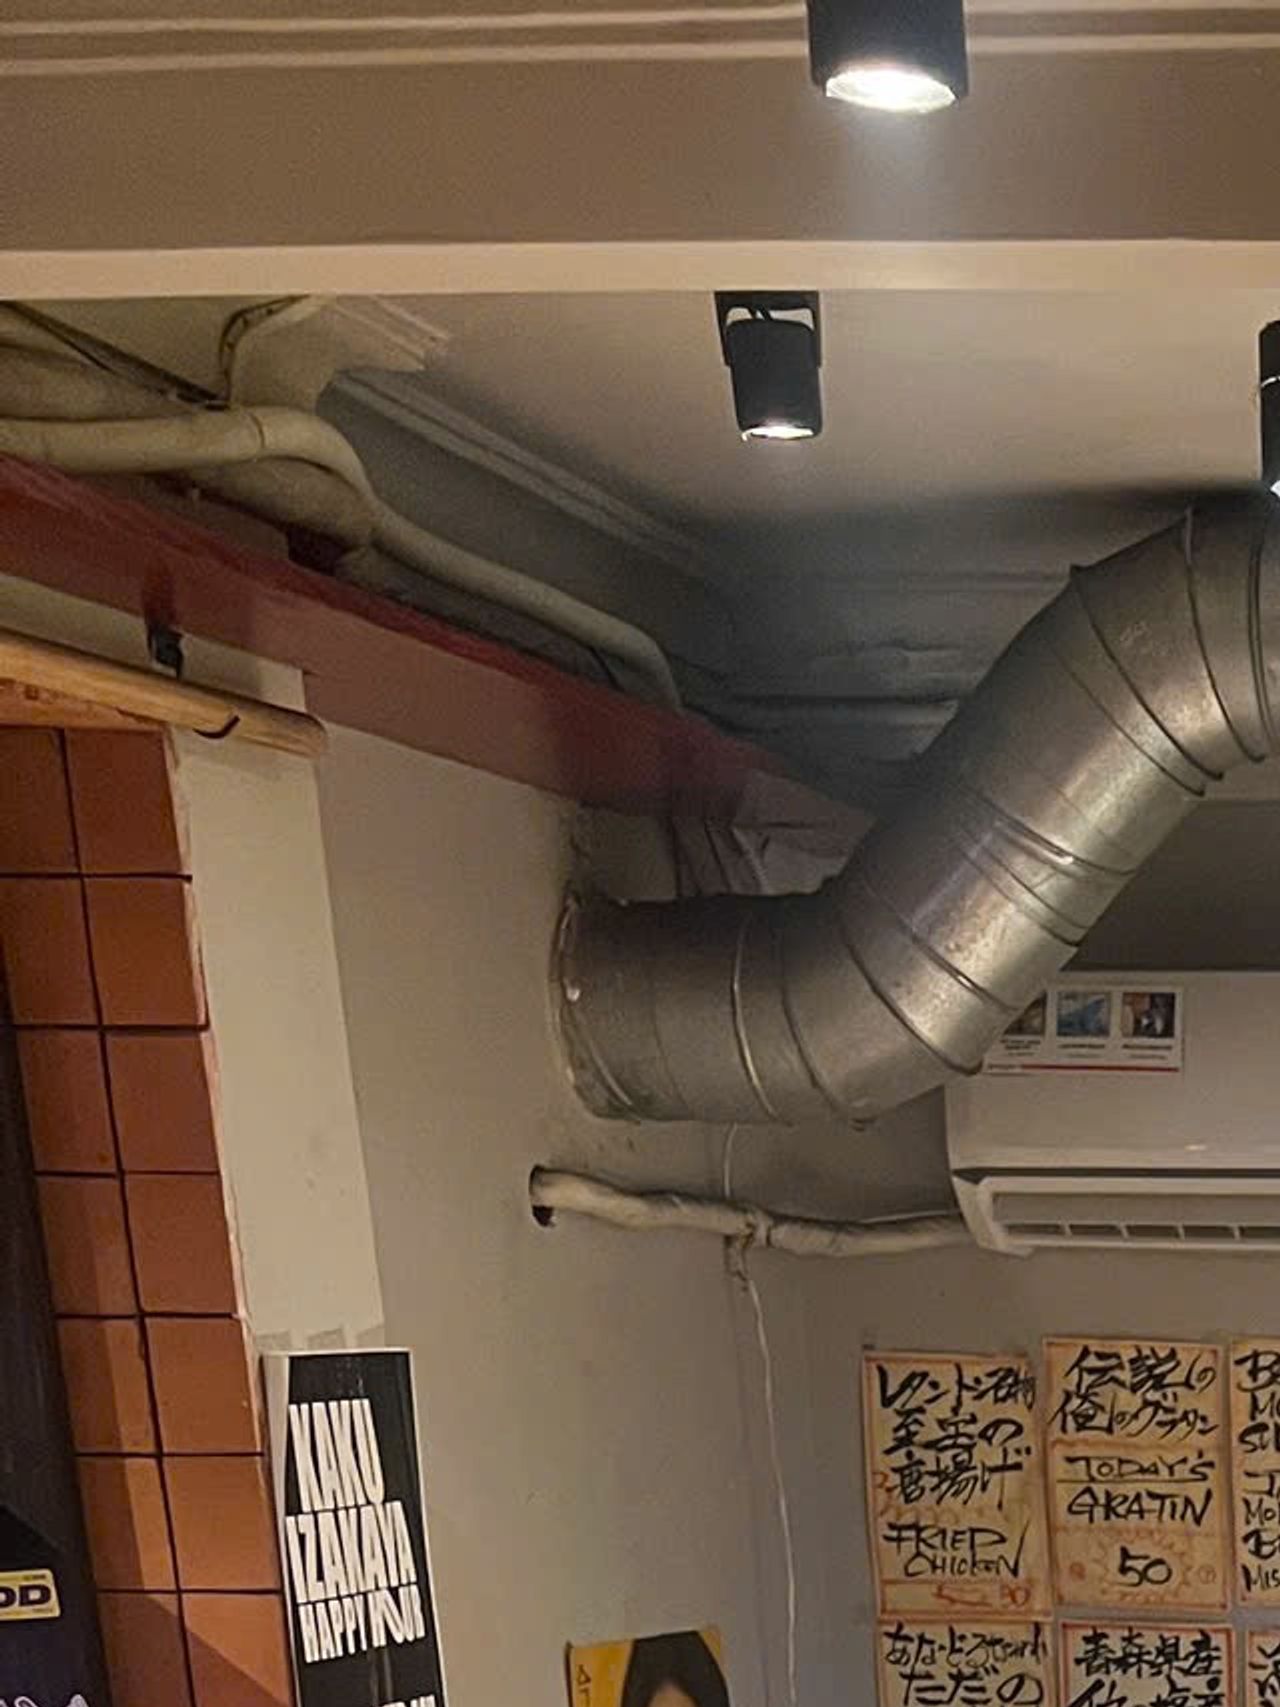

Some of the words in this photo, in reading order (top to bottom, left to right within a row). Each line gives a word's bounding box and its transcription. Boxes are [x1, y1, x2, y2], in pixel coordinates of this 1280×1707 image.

[289, 1399, 385, 1512] KAKU
[285, 1501, 417, 1603] IZAKAYA
[882, 1521, 1007, 1556] FRIED
[1117, 1548, 1173, 1586] 50
[900, 1666, 1044, 1706] ただの
